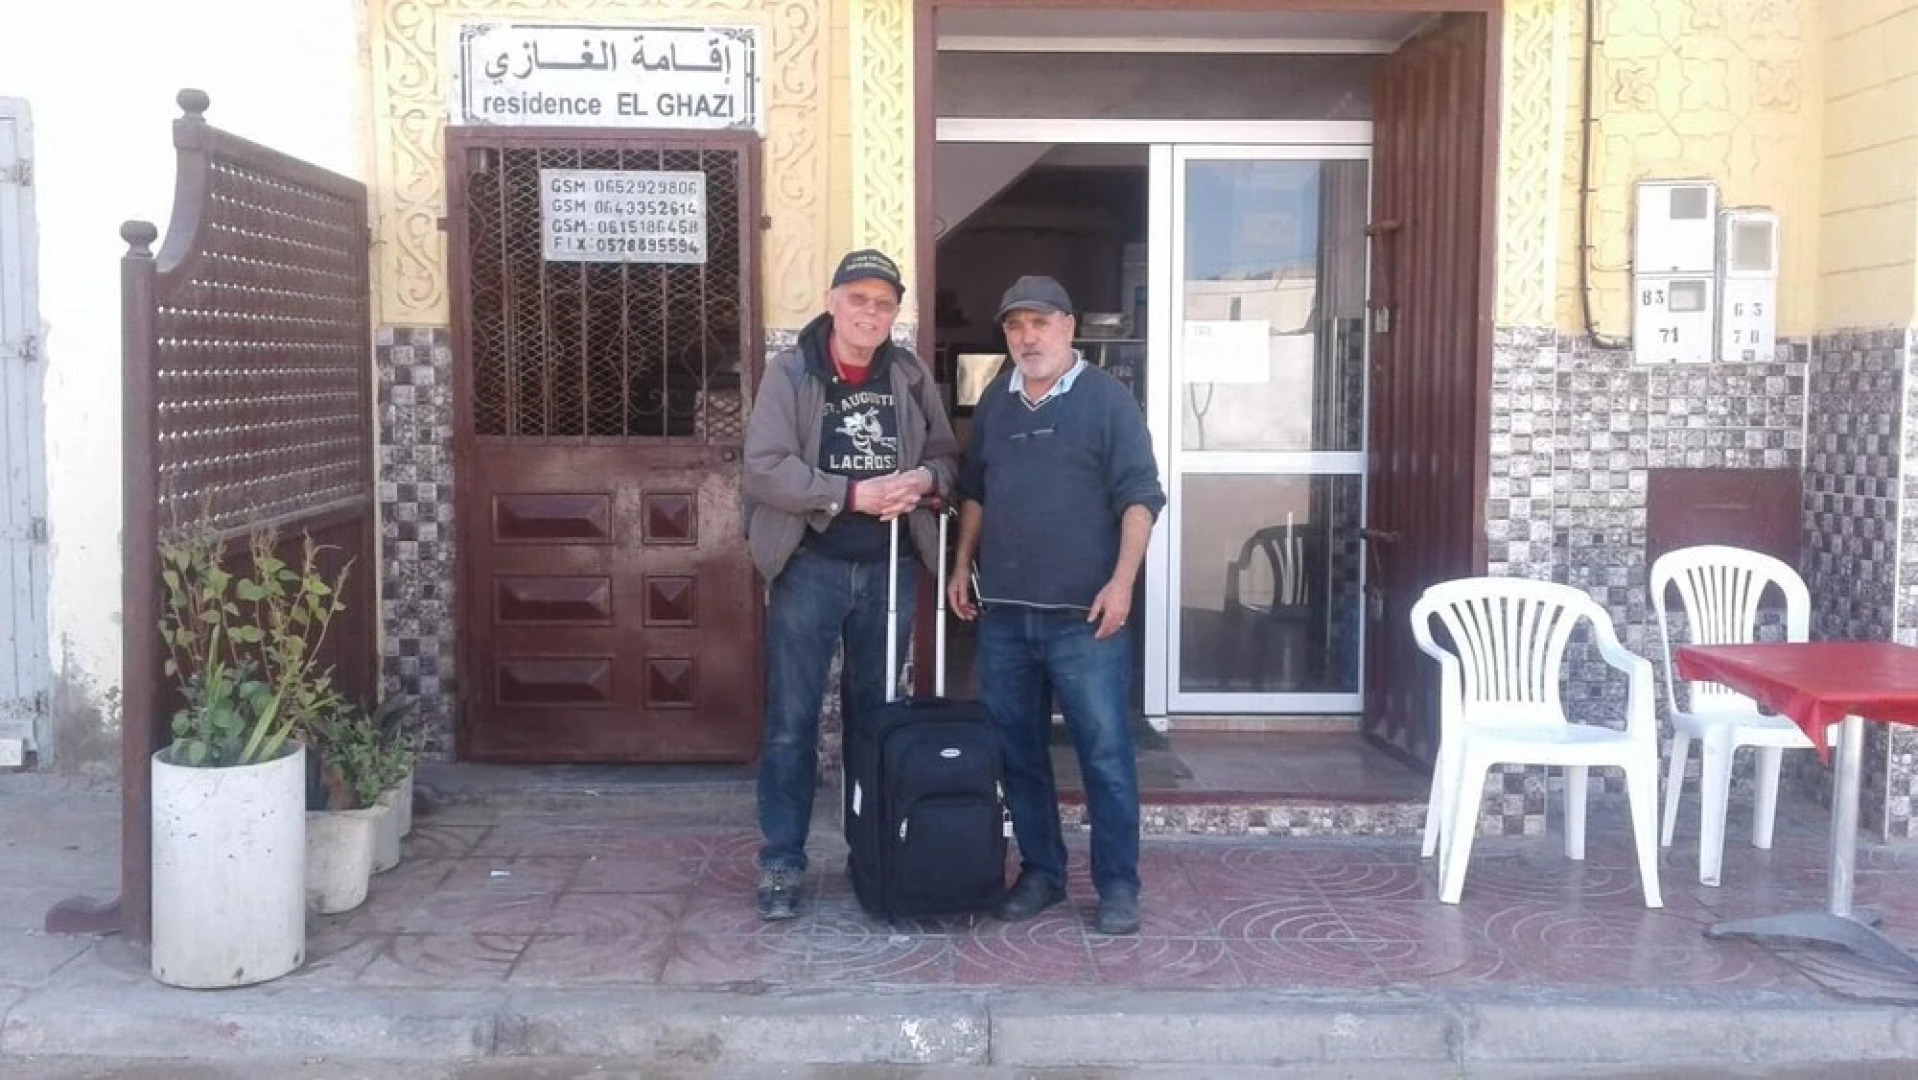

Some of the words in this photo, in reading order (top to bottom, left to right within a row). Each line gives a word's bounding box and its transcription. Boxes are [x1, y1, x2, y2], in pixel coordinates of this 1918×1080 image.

[631, 34, 732, 84] إقامة
[482, 91, 602, 115] residence
[617, 93, 648, 116] EL
[657, 93, 734, 118] GHAZI
